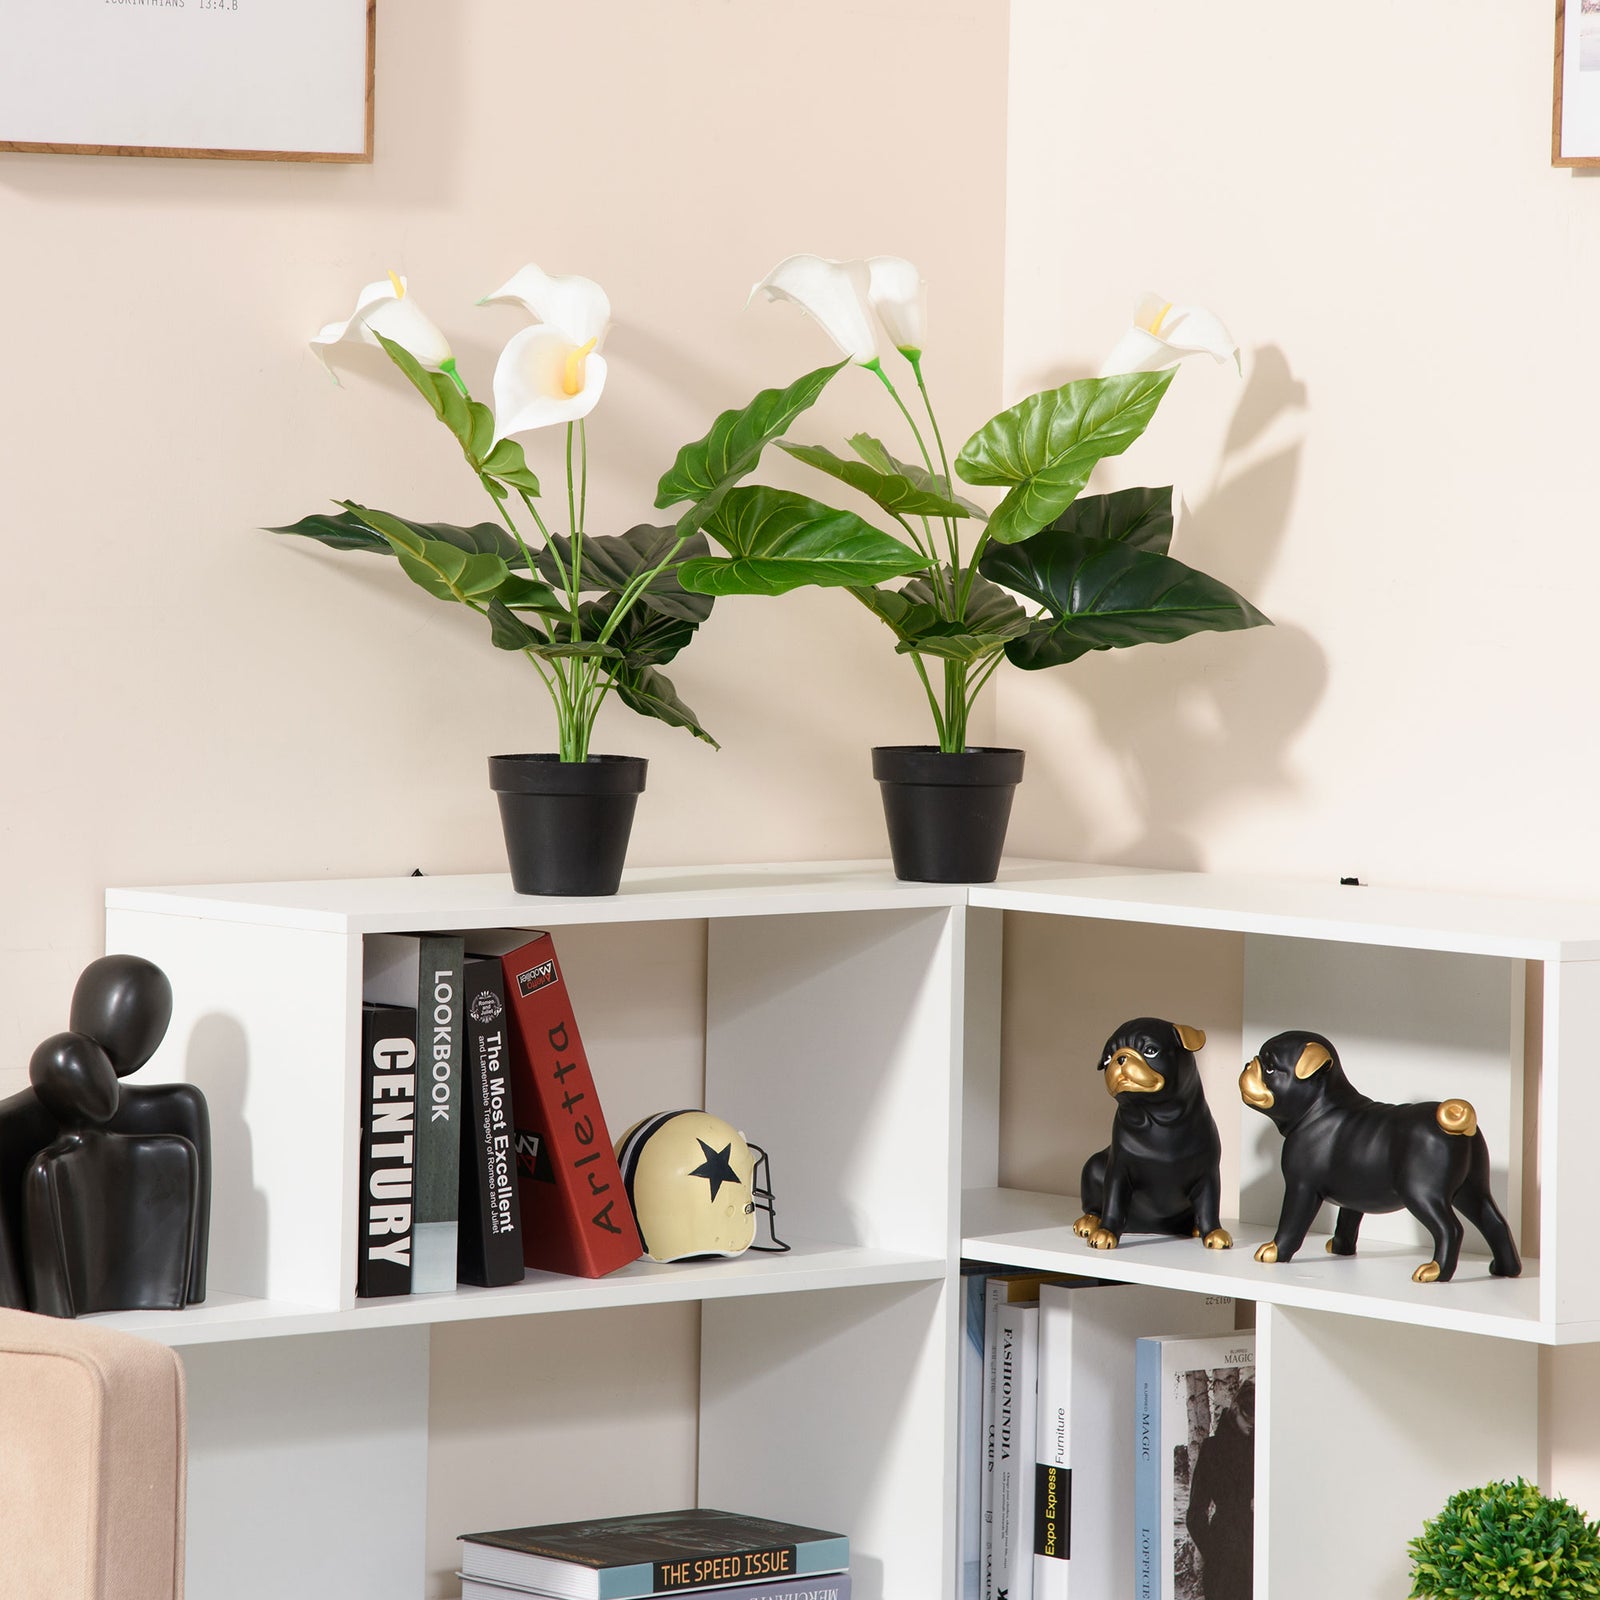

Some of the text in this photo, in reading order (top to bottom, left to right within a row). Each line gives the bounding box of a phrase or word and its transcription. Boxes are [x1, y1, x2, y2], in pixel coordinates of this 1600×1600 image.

[105, 0, 186, 8] RINTHIANS
[432, 970, 452, 1122] LOOKBOOK
[480, 1054, 490, 1106] Lamentable
[483, 1108, 493, 1145] Tragedy
[487, 1031, 514, 1233] The Most Excellent
[487, 1146, 494, 1156] of
[549, 1021, 622, 1235] Arletta
[369, 1037, 415, 1267] CENTURY
[487, 1157, 496, 1190] Romeo
[489, 1191, 498, 1209] and
[491, 1210, 499, 1235] Juliet
[1224, 1352, 1254, 1364] MAGIC
[1001, 1328, 1013, 1461] FASHIONINDIA
[1055, 1407, 1065, 1465] Furniture
[1142, 1413, 1150, 1462] MAGIC
[1045, 1467, 1058, 1555] Expo Express
[661, 1550, 790, 1586] THE SPEED ISSUE
